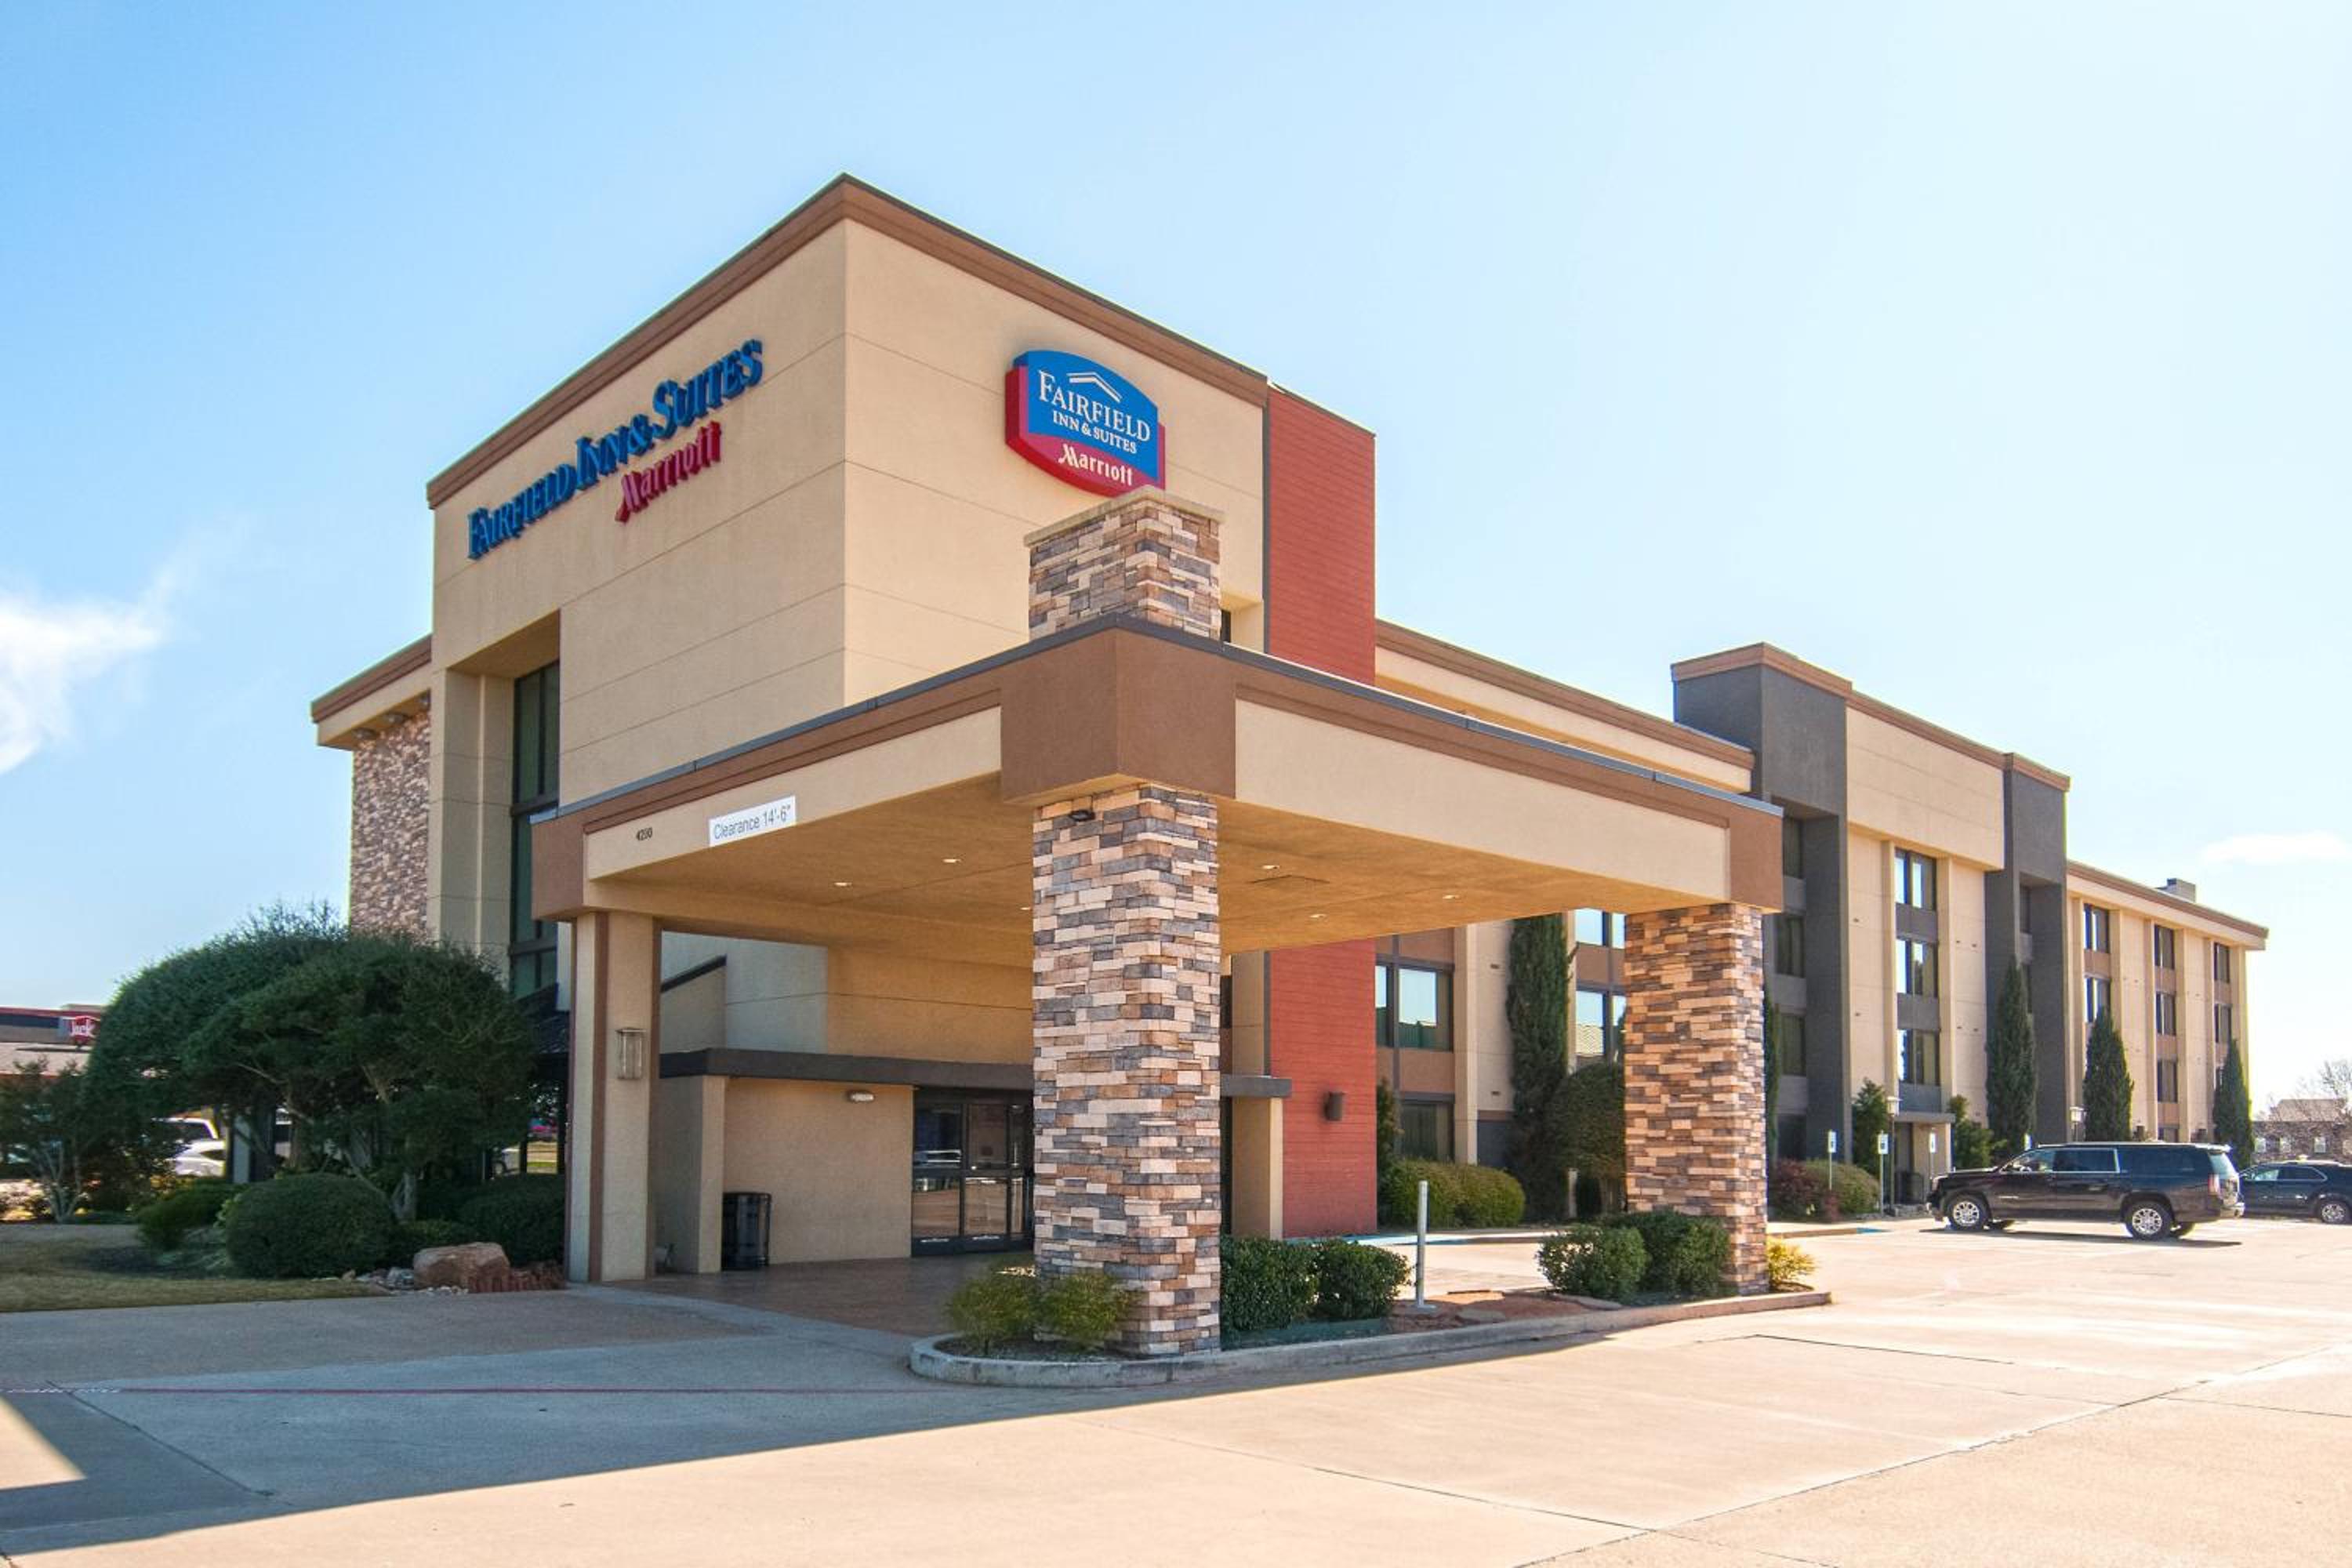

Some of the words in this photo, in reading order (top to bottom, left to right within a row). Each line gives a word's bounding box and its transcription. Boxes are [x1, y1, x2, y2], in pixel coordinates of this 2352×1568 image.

[1038, 369, 1150, 442] FAIRFIELD
[1053, 410, 1080, 431] INN
[1094, 426, 1137, 454] SUITES
[615, 421, 721, 524] Marriott
[1058, 443, 1133, 486] Marriott
[468, 463, 577, 560] FAIRFIELD
[714, 816, 760, 840] Clearance
